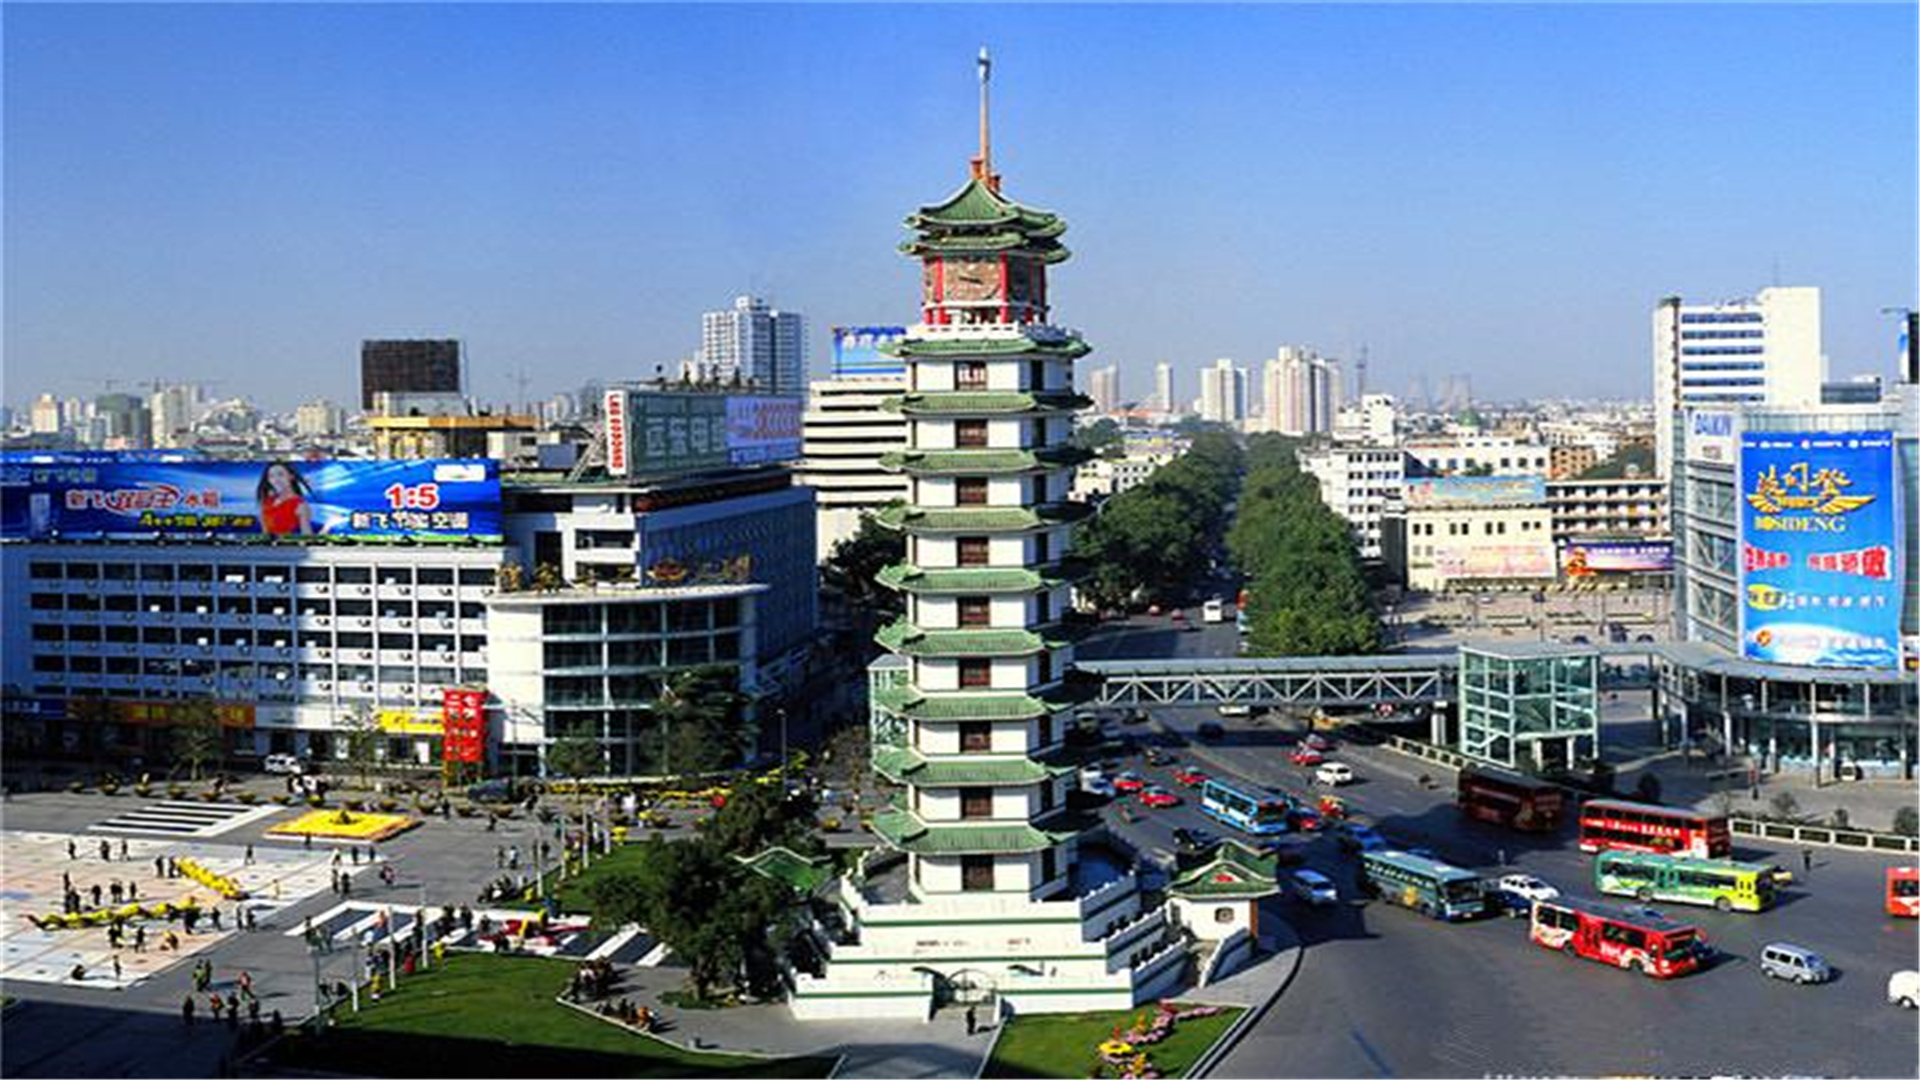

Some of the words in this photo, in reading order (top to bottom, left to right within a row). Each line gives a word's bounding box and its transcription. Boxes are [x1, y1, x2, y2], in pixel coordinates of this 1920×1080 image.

[386, 483, 439, 509] 1:5
[1756, 463, 1855, 499] 波司登
